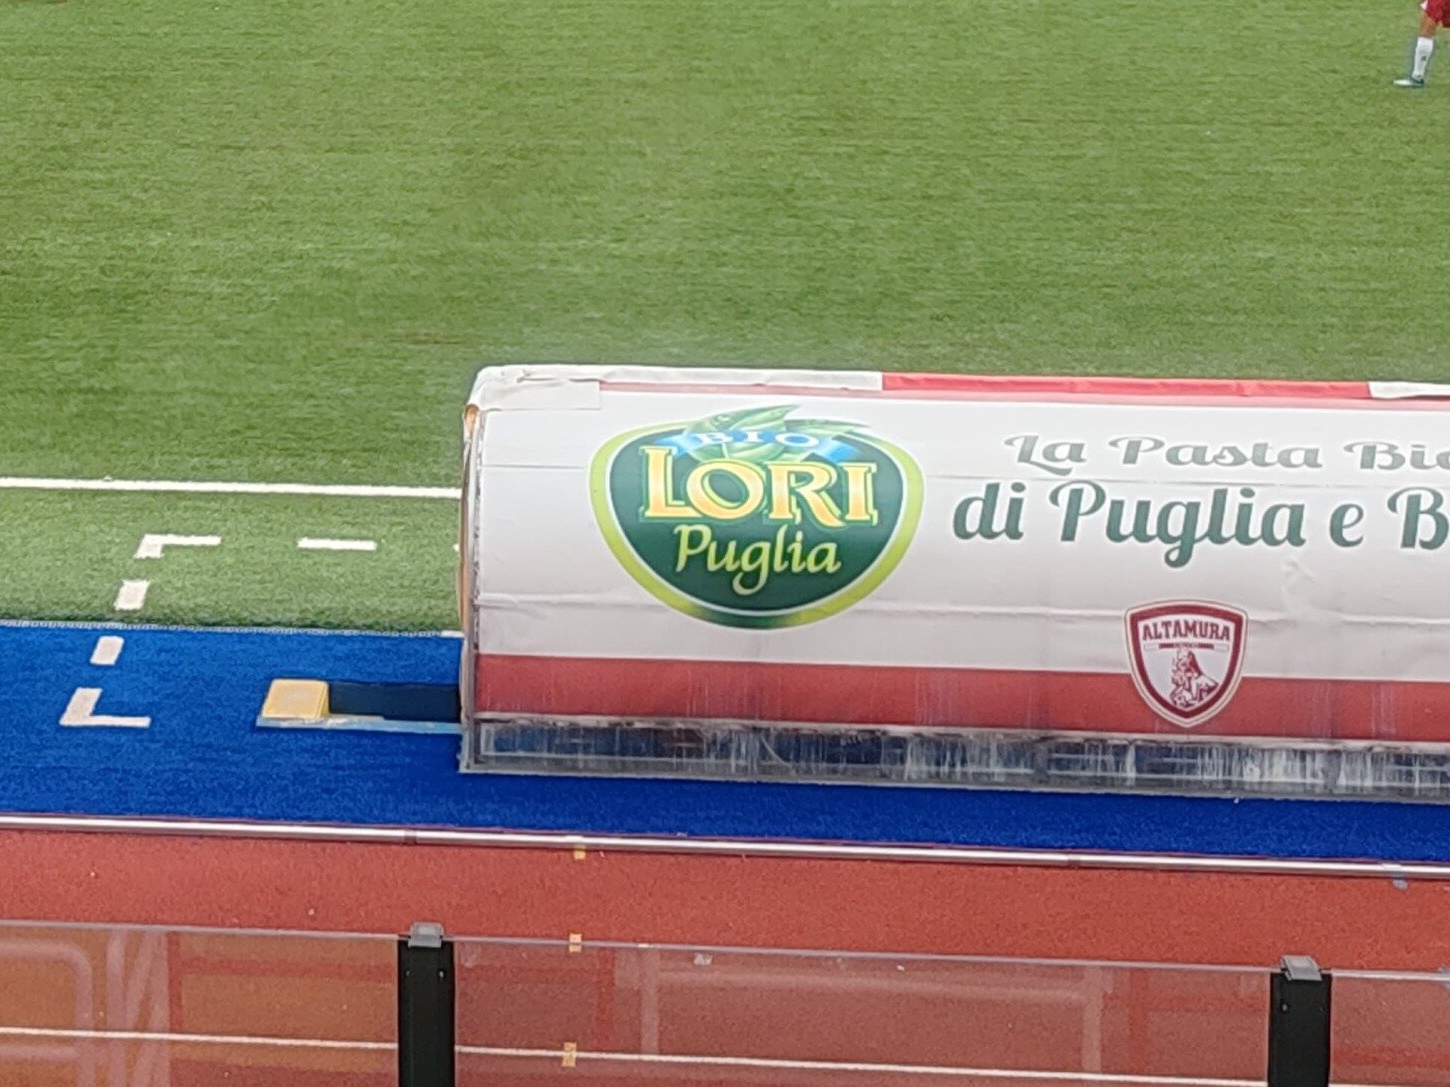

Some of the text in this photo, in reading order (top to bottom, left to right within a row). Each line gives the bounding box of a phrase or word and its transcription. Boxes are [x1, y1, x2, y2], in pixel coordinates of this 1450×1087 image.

[641, 447, 880, 528] LORI
[1004, 435, 1087, 475] La
[1108, 436, 1323, 468] Pasta
[953, 482, 1026, 540] di
[1049, 480, 1307, 568] Puglia
[1329, 502, 1364, 547] e
[673, 525, 842, 595] Puglia
[1142, 620, 1230, 641] ALTAMURA
